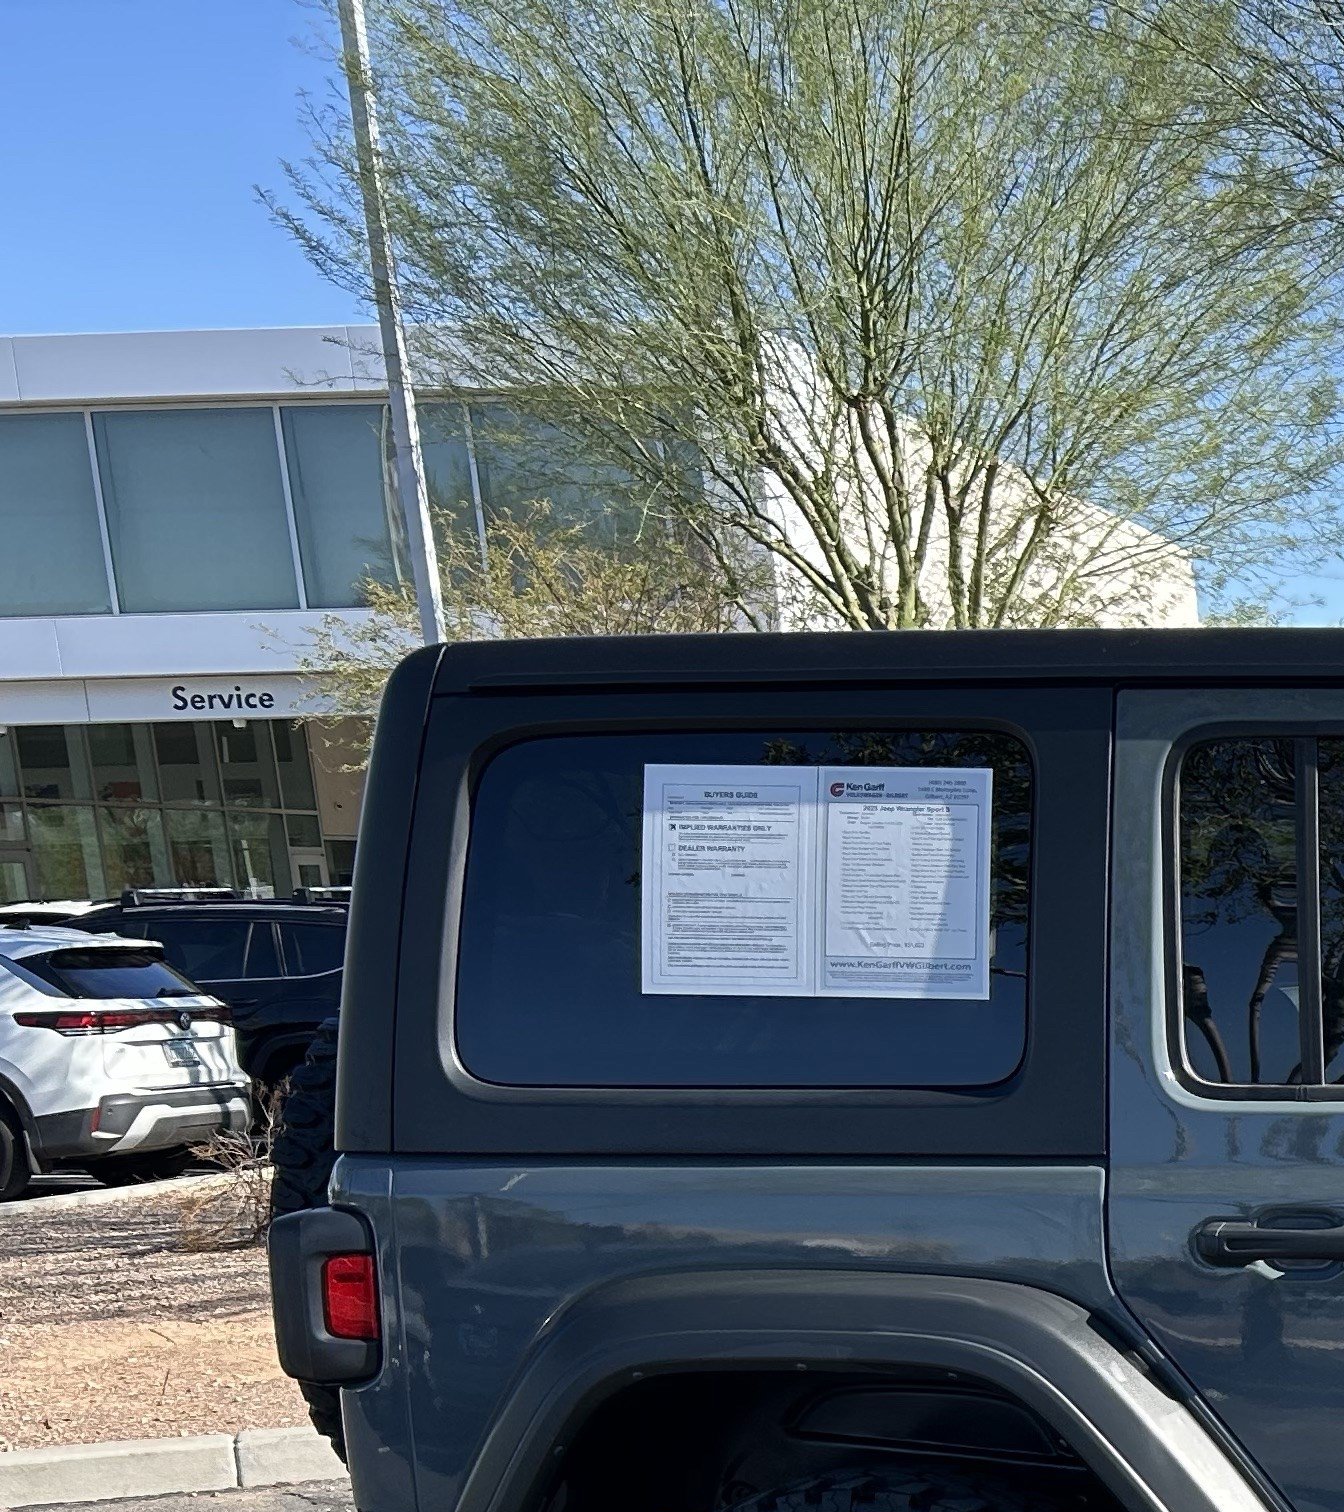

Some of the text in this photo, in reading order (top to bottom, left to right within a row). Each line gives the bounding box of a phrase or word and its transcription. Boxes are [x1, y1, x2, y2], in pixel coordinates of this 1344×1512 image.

[171, 685, 275, 711] Service
[846, 782, 863, 791] Ken
[704, 791, 734, 799] BUYERS
